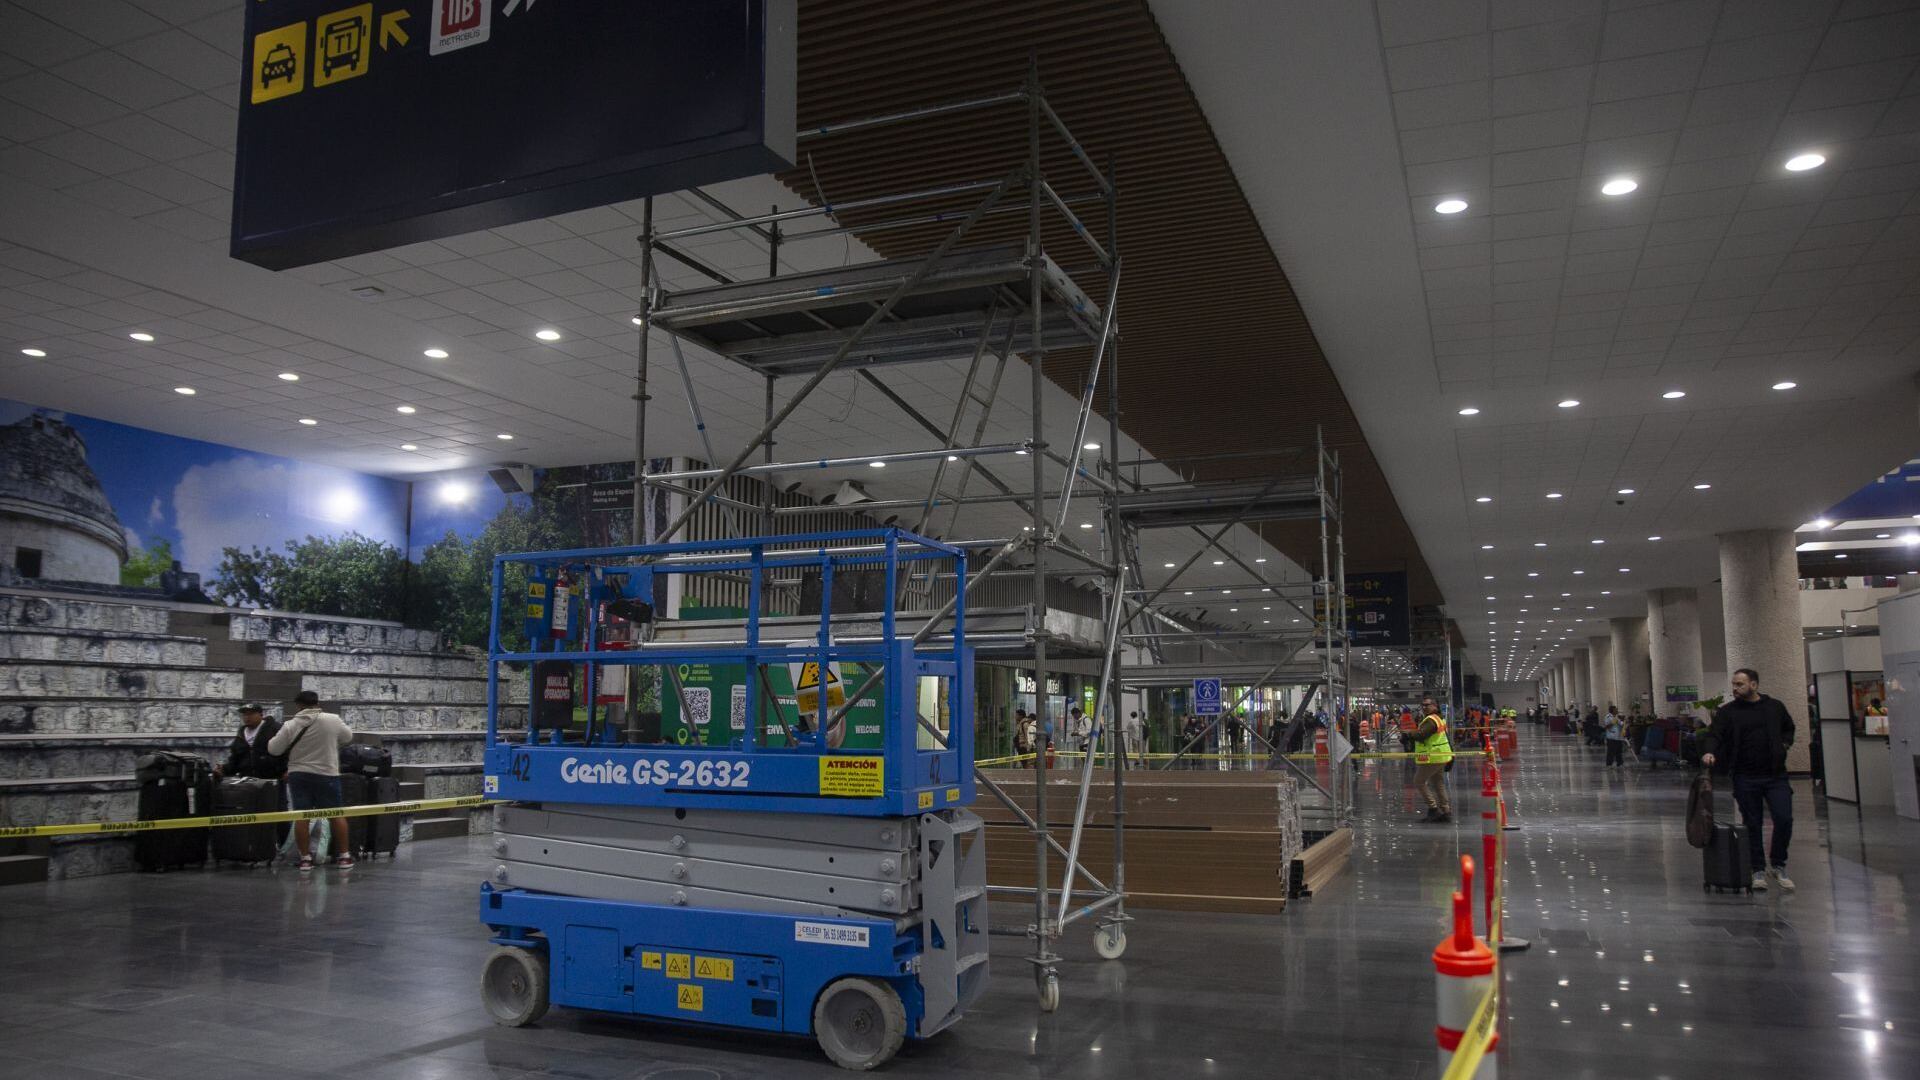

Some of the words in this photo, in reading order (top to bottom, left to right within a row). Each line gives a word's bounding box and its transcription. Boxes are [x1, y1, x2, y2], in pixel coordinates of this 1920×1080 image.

[335, 32, 353, 53] T1
[855, 725, 881, 734] WELCOME
[512, 754, 531, 782] 42
[560, 758, 627, 784] Genie
[632, 759, 749, 788] GS-2632
[827, 760, 878, 769] ATENCIÓN
